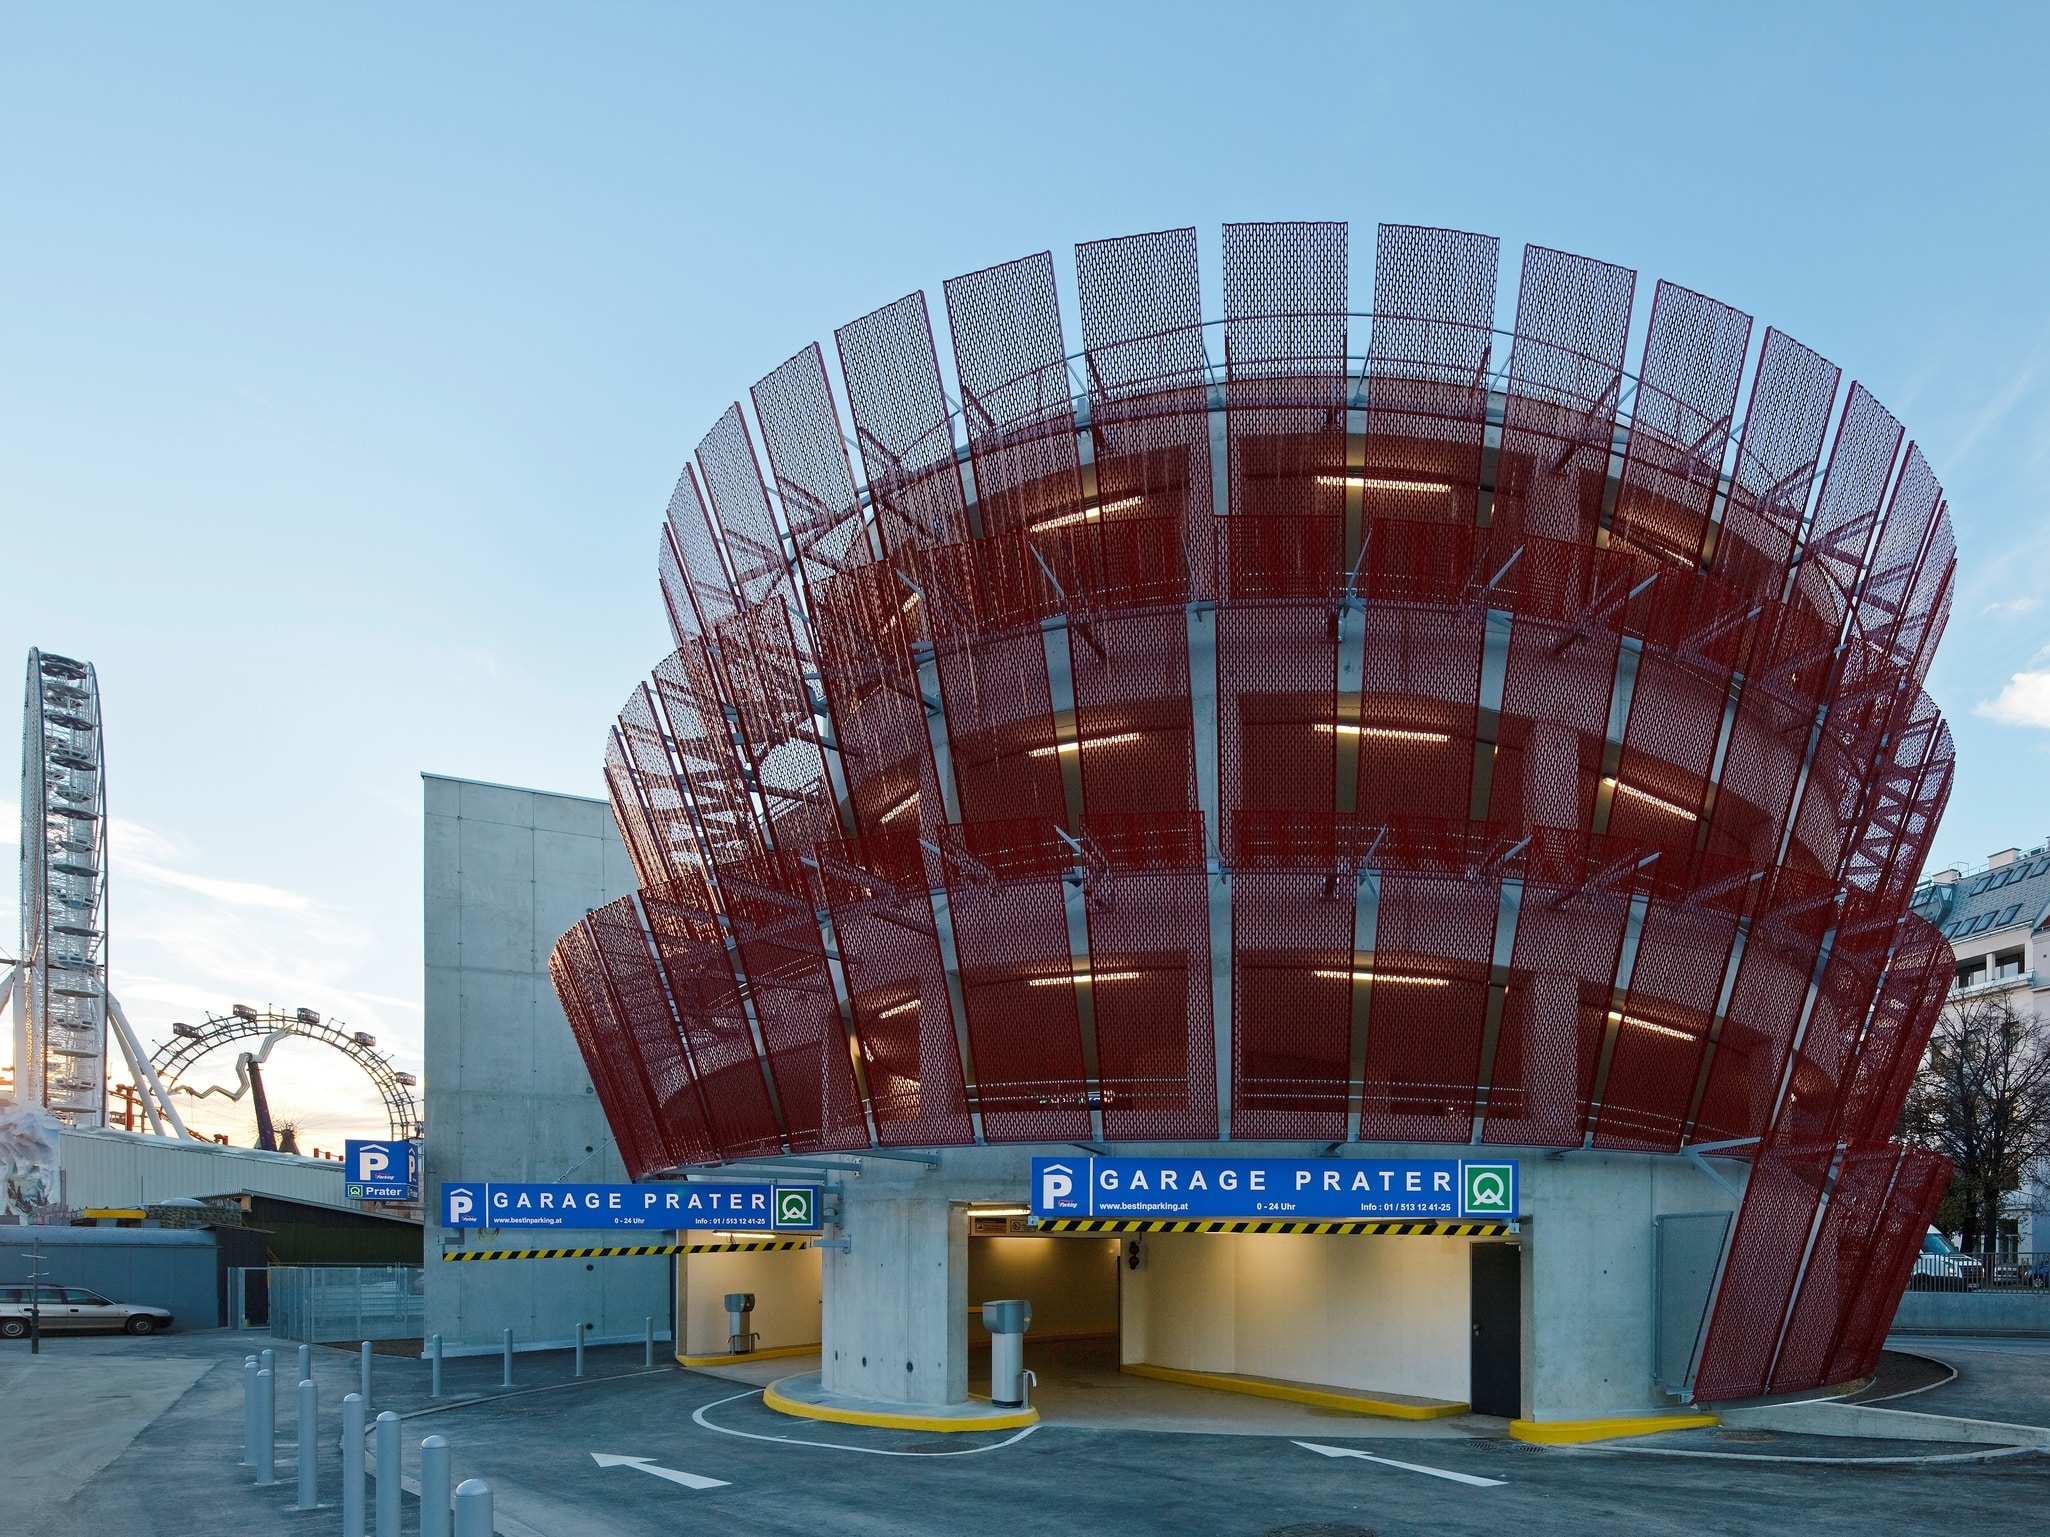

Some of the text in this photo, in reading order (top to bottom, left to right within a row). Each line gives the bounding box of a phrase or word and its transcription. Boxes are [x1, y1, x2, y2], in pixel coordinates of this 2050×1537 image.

[360, 1152, 389, 1181] P
[1099, 1169, 1452, 1192] GARAGE PRATER
[366, 1187, 402, 1196] Prater
[1043, 1174, 1073, 1210] P
[493, 1192, 766, 1209] GARAGE PRATER
[1099, 1202, 1189, 1212] www.bestinparking.at
[1256, 1202, 1263, 1211] 0
[1269, 1202, 1279, 1211] 24
[1280, 1202, 1296, 1211] Uhr
[1361, 1203, 1377, 1211] Info
[1384, 1203, 1394, 1211] 01
[1400, 1203, 1415, 1211] 513
[1417, 1203, 1427, 1211] 12
[1428, 1203, 1451, 1211] 41-25
[450, 1196, 473, 1223] P
[493, 1217, 562, 1225] www.bestinparking.at
